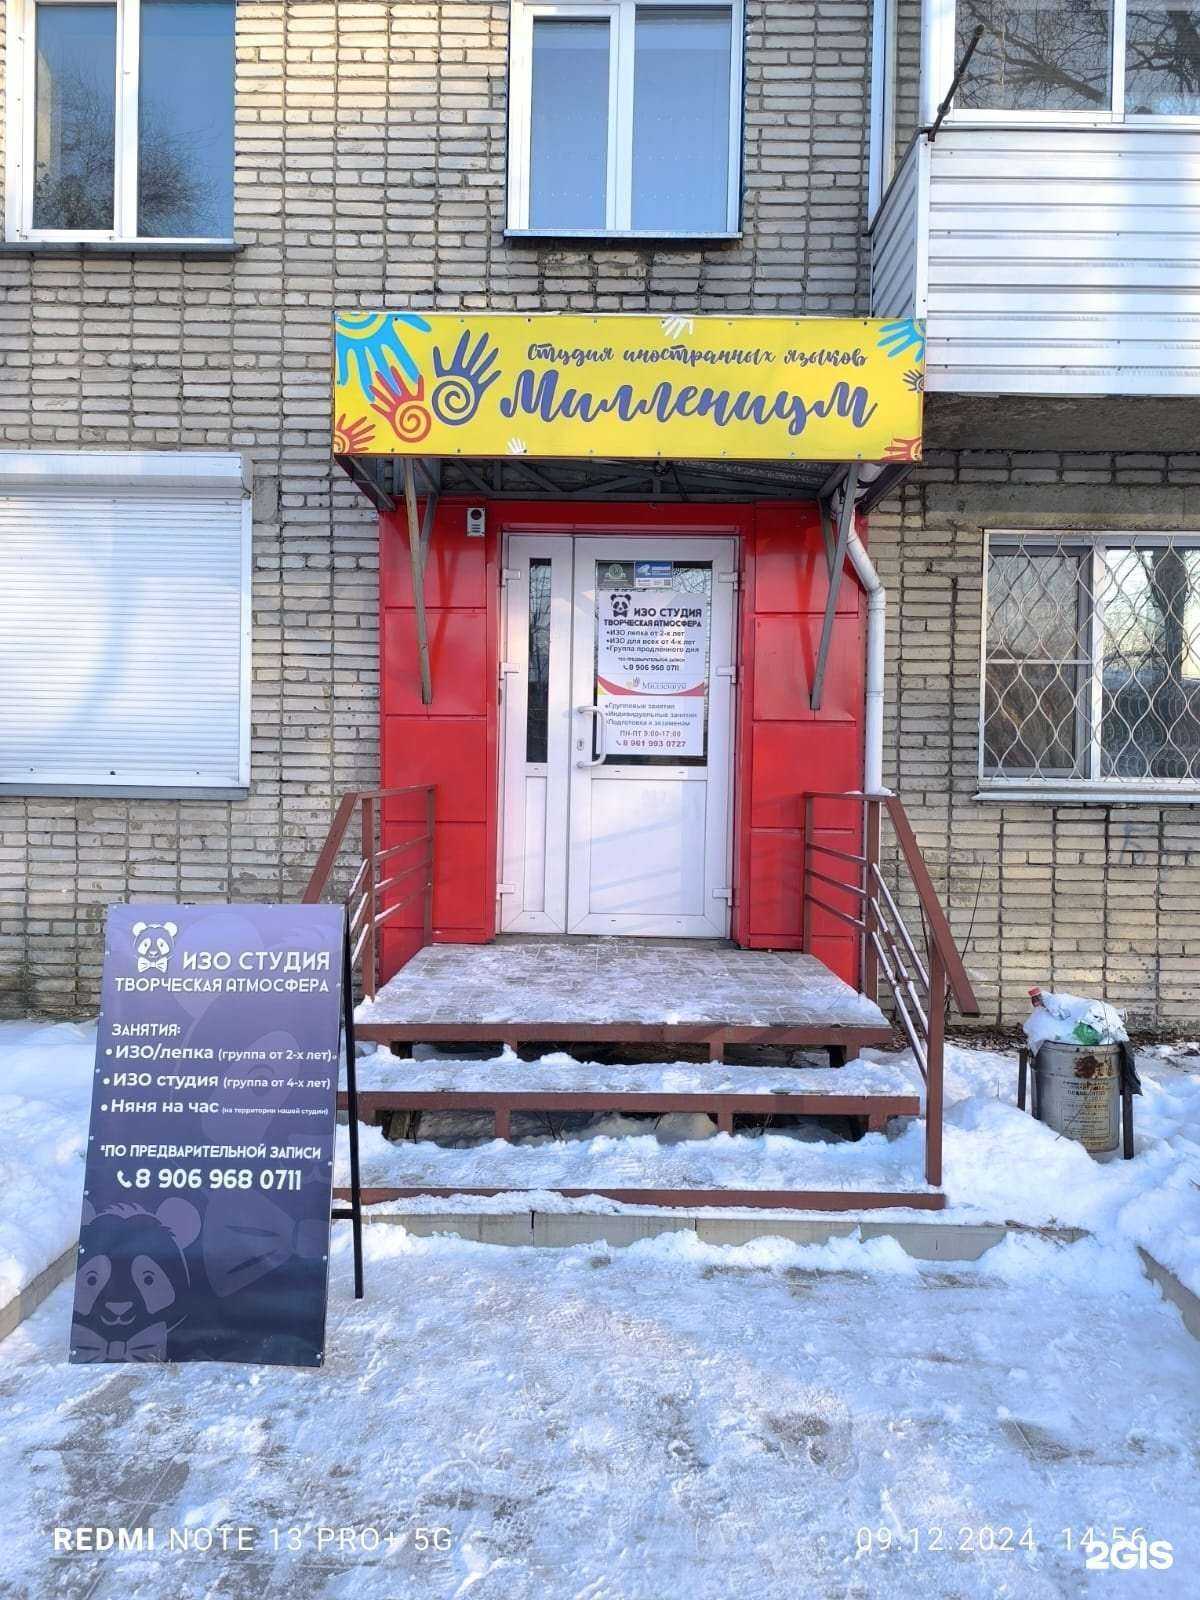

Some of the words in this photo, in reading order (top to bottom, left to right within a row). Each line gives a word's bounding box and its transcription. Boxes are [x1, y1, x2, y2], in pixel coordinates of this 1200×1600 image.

[624, 344, 775, 367] иностранных
[784, 347, 868, 367] языков
[499, 369, 878, 436] Миллениум
[634, 608, 656, 617] ИЗО
[660, 608, 702, 618] СТУДИЯ
[604, 619, 652, 627] ТВОРЧЕСКАЯ
[610, 645, 634, 653] Группа
[183, 952, 231, 971] ИЗО
[239, 952, 330, 973] СТУДИЯ
[115, 978, 222, 992] ТВОРЧЕСКАЯ
[226, 978, 329, 993] АТМОСФЕРА
[111, 1023, 181, 1037] ЗАНЯТИЯ:
[115, 1043, 214, 1060] ИЗО/лепка
[218, 1050, 266, 1062] (группа
[269, 1052, 282, 1060] от
[286, 1050, 304, 1060] 2-х
[306, 1050, 332, 1062] лет)
[113, 1073, 151, 1087] ИЗО
[157, 1076, 218, 1089] студия
[223, 1077, 269, 1089] (группа
[271, 1079, 284, 1088] от
[286, 1078, 304, 1088] 4-х
[306, 1078, 331, 1090] лет)
[111, 1099, 157, 1113] Няня
[162, 1102, 184, 1113] на
[188, 1102, 219, 1113] час
[130, 1144, 266, 1159] ПРЕДВАРИТЕЛЬНОЙ
[270, 1147, 321, 1159] ЗАПИСИ
[135, 1169, 151, 1188] 8
[158, 1169, 202, 1188] 906
[209, 1169, 253, 1189] 968
[259, 1170, 302, 1190] 0711
